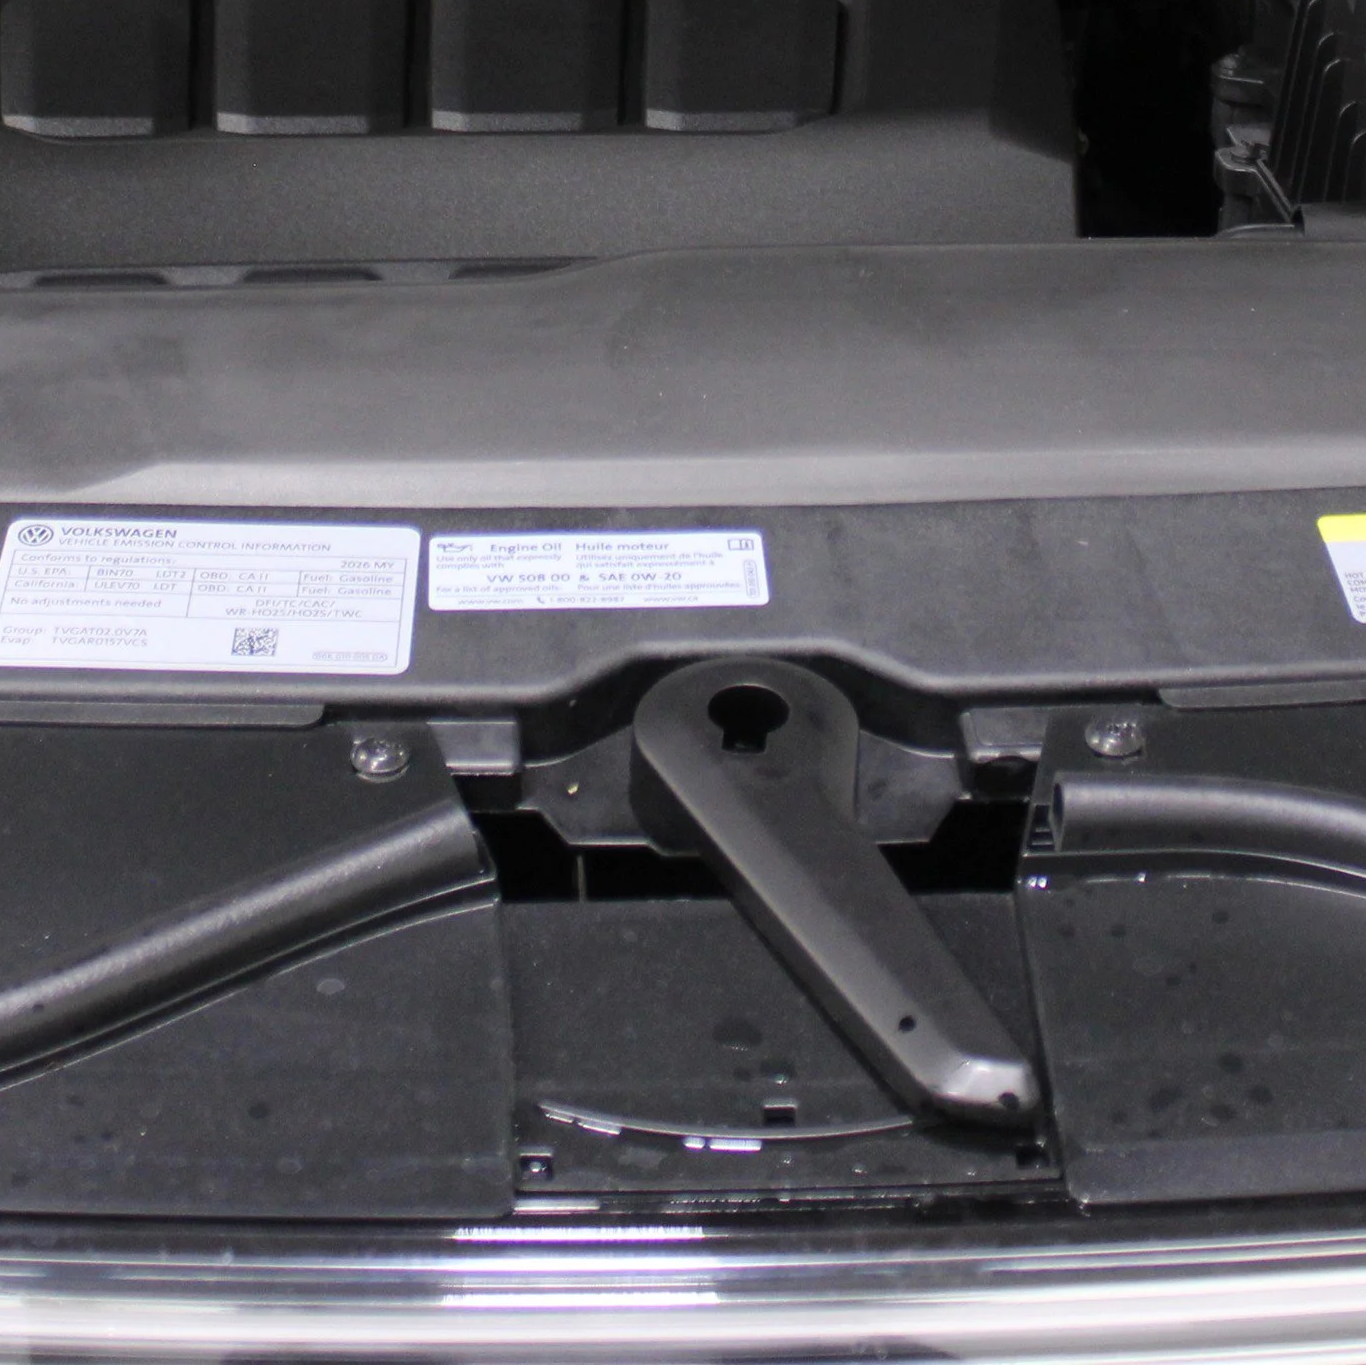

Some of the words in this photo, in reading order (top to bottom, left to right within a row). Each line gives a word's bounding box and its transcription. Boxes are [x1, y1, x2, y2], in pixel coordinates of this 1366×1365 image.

[62, 526, 177, 539] VOLKSWAGEN
[59, 538, 111, 547] VEHICLE
[113, 539, 174, 549] EMISSION
[177, 540, 236, 550] CONTROL
[241, 542, 332, 553] INFORMATION
[490, 544, 537, 554] Engine
[542, 542, 562, 552] Oil
[576, 542, 612, 552] Huile
[617, 543, 670, 552] moteur
[21, 553, 81, 562] Conforms
[85, 554, 96, 563] to
[340, 560, 370, 569] 2026
[374, 561, 395, 570] MY
[481, 562, 504, 570] with
[156, 570, 187, 579] LDT2
[239, 572, 255, 581] CA
[339, 574, 394, 584] Gasoline
[486, 574, 514, 583] VW
[518, 573, 546, 583] 508
[550, 573, 571, 583] 00
[598, 573, 626, 582] SAE
[153, 582, 177, 591] LDT
[237, 585, 253, 593] CA
[338, 587, 392, 596] Gasoline
[10, 597, 26, 606] No
[29, 598, 110, 610] adjustments
[113, 599, 162, 608] needed
